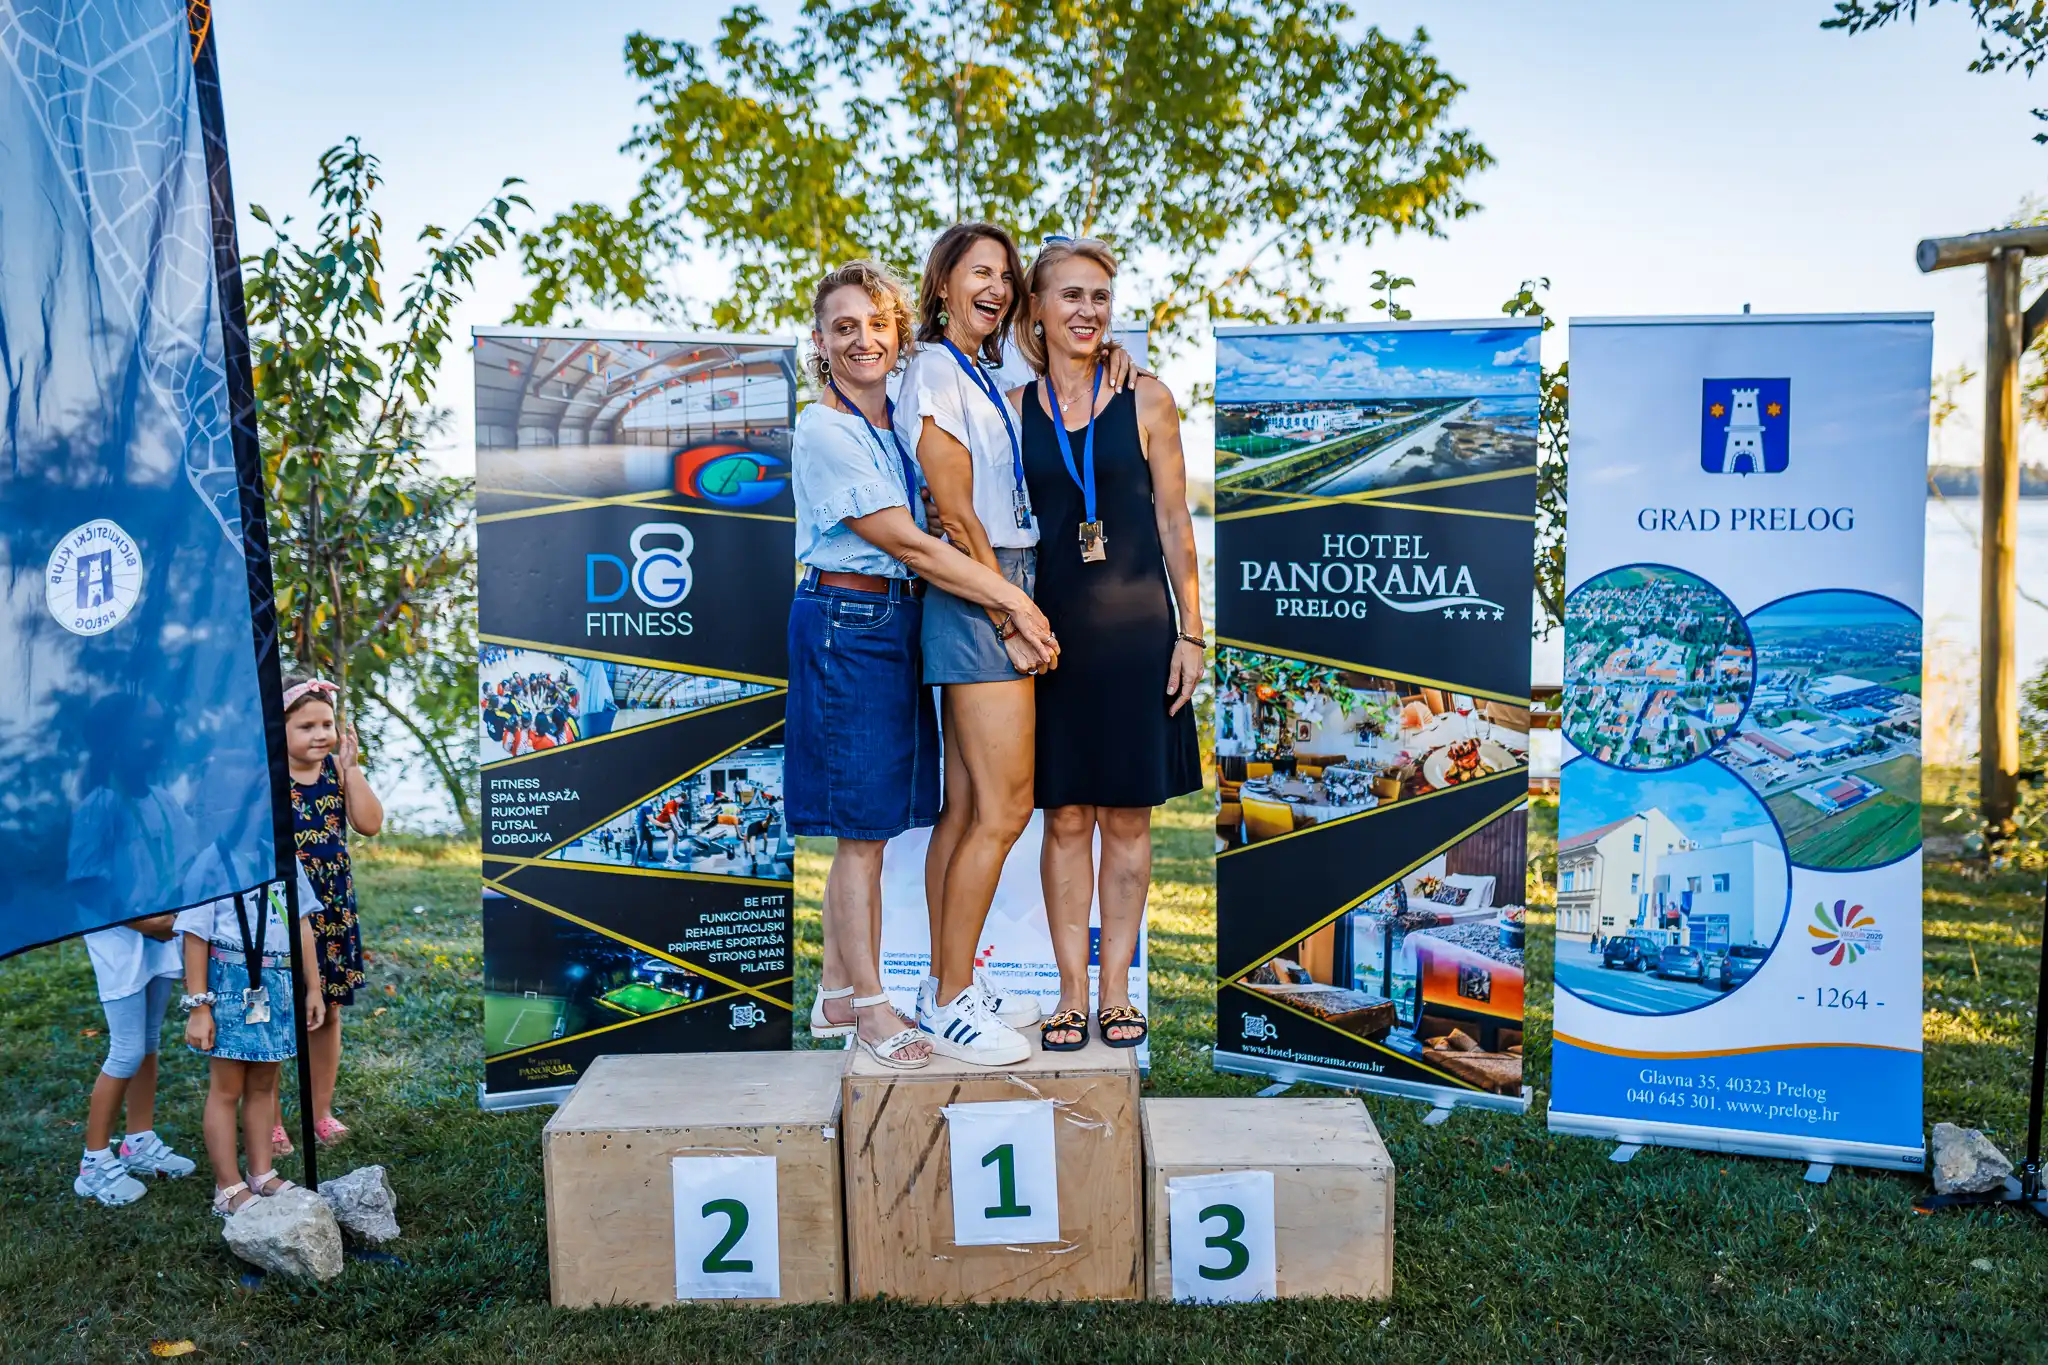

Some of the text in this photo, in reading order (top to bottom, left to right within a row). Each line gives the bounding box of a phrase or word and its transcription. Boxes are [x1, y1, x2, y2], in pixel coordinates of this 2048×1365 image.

[1637, 507, 1855, 532] GRAD PRELOG
[1322, 533, 1430, 559] HOTEL
[1239, 561, 1480, 597] PANORAMA
[1275, 598, 1368, 619] PRELOG
[586, 612, 693, 637] FITNESS
[490, 778, 541, 790] FITNESS
[491, 788, 581, 804] SPA & MASAŽA
[491, 805, 551, 817] RUKOMET
[491, 820, 539, 831] FUTSAL
[491, 832, 553, 845] ODBOJKA
[744, 895, 786, 908] BE FITT
[699, 908, 785, 924] FUNKCIONALNI
[685, 921, 785, 939] REHABILITACIJSKI
[1866, 932, 1884, 941] 2020
[668, 932, 786, 954] PRIPREME SPORTAŠA
[708, 947, 785, 963] STRONG MAN
[740, 960, 785, 973] PILATES
[888, 984, 920, 992] sufinanc
[1042, 988, 1060, 996] fond
[1816, 987, 1869, 1010] 1264
[1241, 1043, 1386, 1073] www.hotel-panorama.com.hr
[519, 1063, 573, 1076] PANORAMA
[1639, 1068, 1827, 1103] Glavna 35, 40323 Prelog
[1626, 1088, 1655, 1104] 040
[1658, 1091, 1685, 1107] 645
[1726, 1099, 1841, 1124] www.prelog.hr
[981, 1143, 1032, 1219] 1
[701, 1198, 754, 1274] 2
[1198, 1203, 1250, 1281] 3
